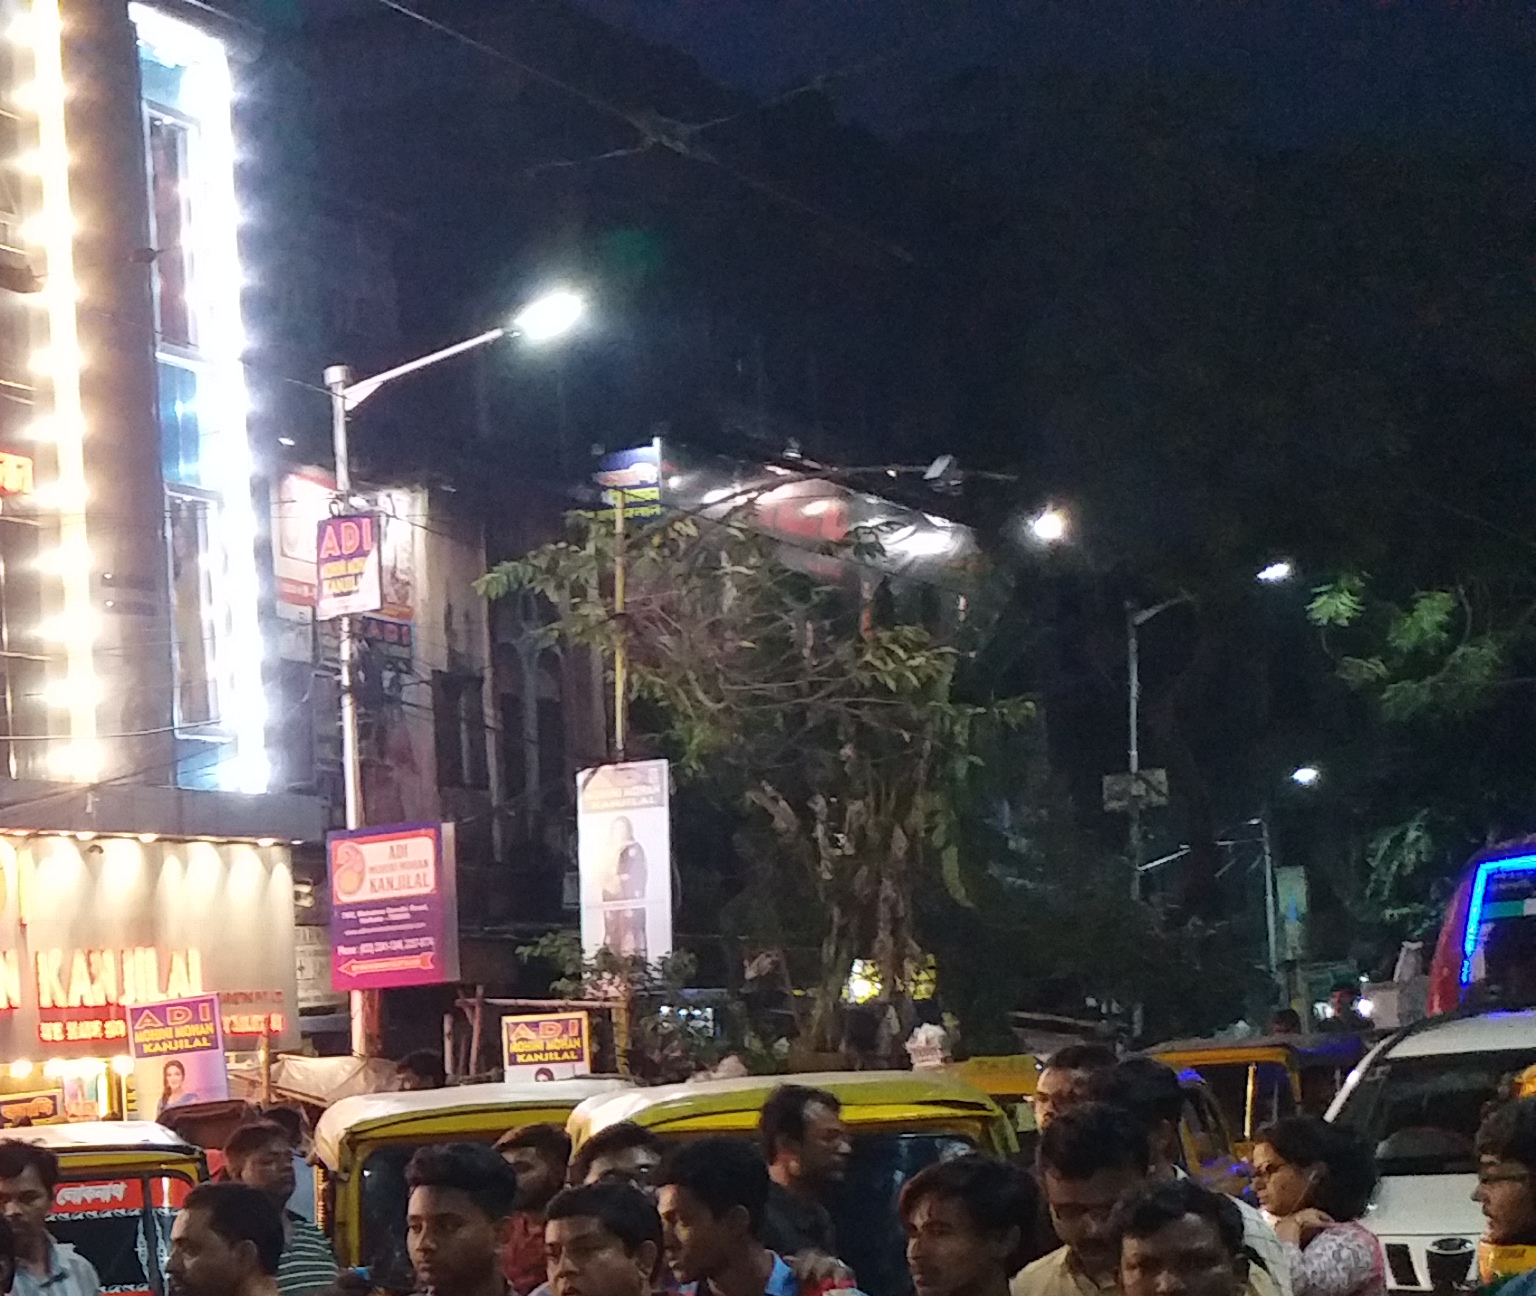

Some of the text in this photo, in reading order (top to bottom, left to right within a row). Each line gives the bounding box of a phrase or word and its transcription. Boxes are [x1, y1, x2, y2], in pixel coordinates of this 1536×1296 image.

[320, 518, 371, 558] ADI
[133, 1002, 212, 1030] ADI
[508, 1021, 580, 1041] ADI
[142, 1037, 212, 1054] KANJILAL
[516, 1049, 579, 1064] KANJILAL
